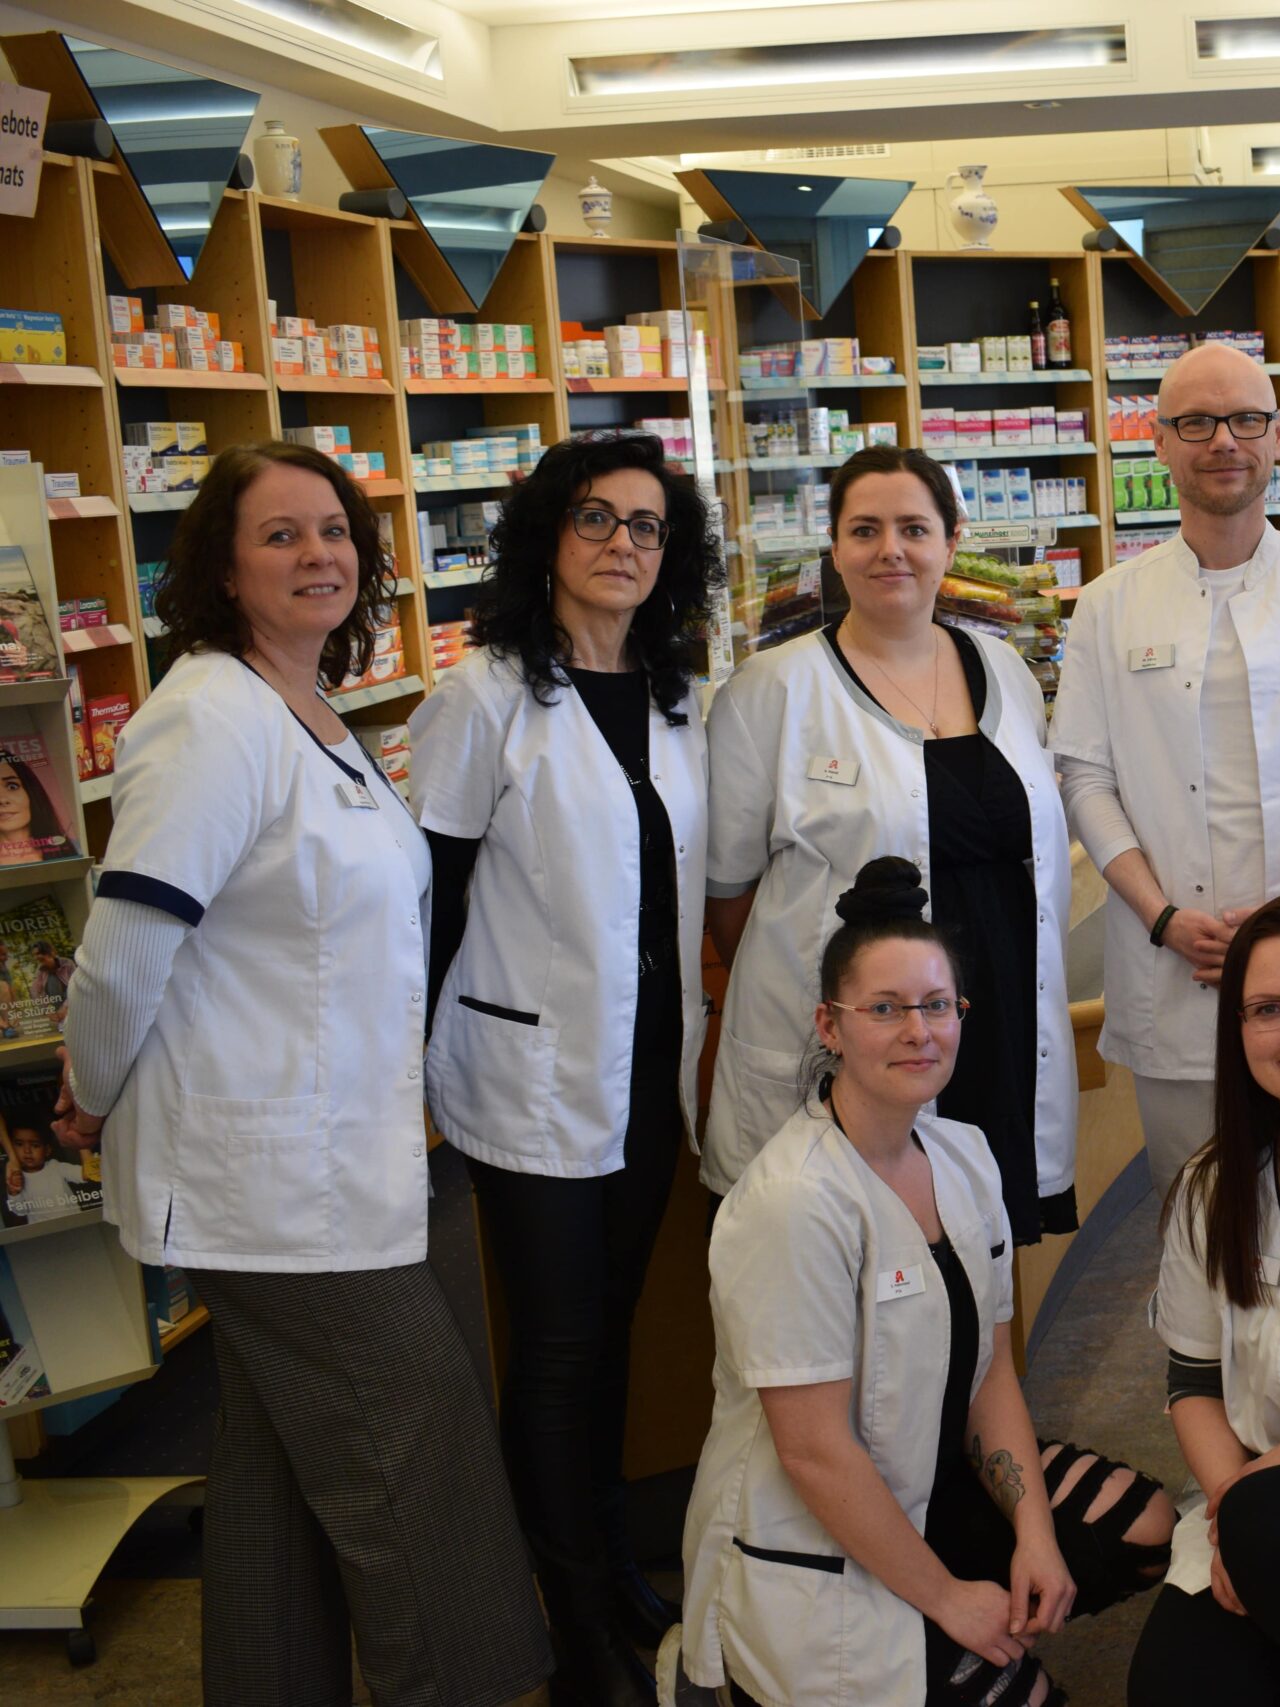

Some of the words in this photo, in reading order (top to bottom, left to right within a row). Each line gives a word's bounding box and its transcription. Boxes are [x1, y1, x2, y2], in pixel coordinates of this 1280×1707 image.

[91, 702, 130, 717] ThermaCare
[9, 994, 63, 1010] vermeiden
[8, 1010, 23, 1020] Sie
[24, 1005, 56, 1018] Stürze
[7, 1199, 54, 1212] Familie
